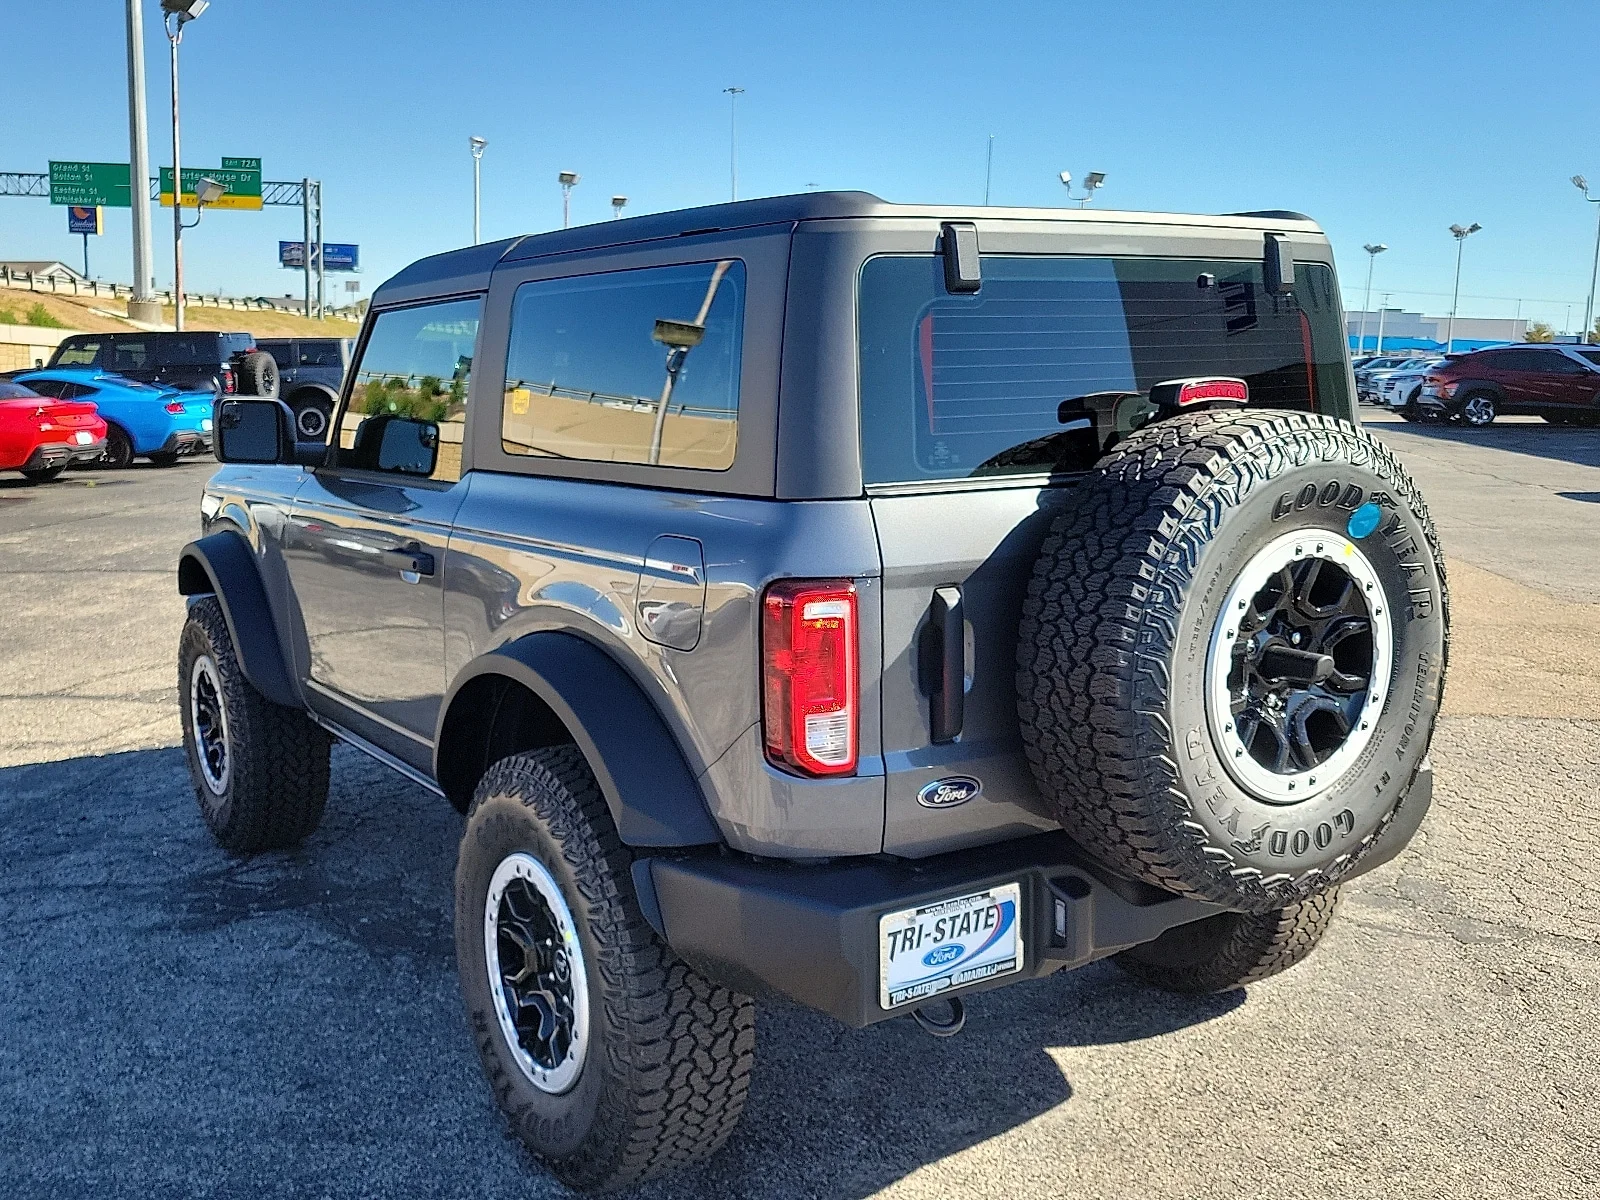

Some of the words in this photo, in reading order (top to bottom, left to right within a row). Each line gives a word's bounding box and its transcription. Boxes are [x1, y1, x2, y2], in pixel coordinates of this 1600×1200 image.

[241, 159, 257, 168] 72A
[167, 172, 204, 181] Qarter
[240, 174, 252, 182] Dr
[933, 784, 968, 804] Ford
[887, 905, 997, 963] TRI-STATE
[930, 946, 959, 965] Ford
